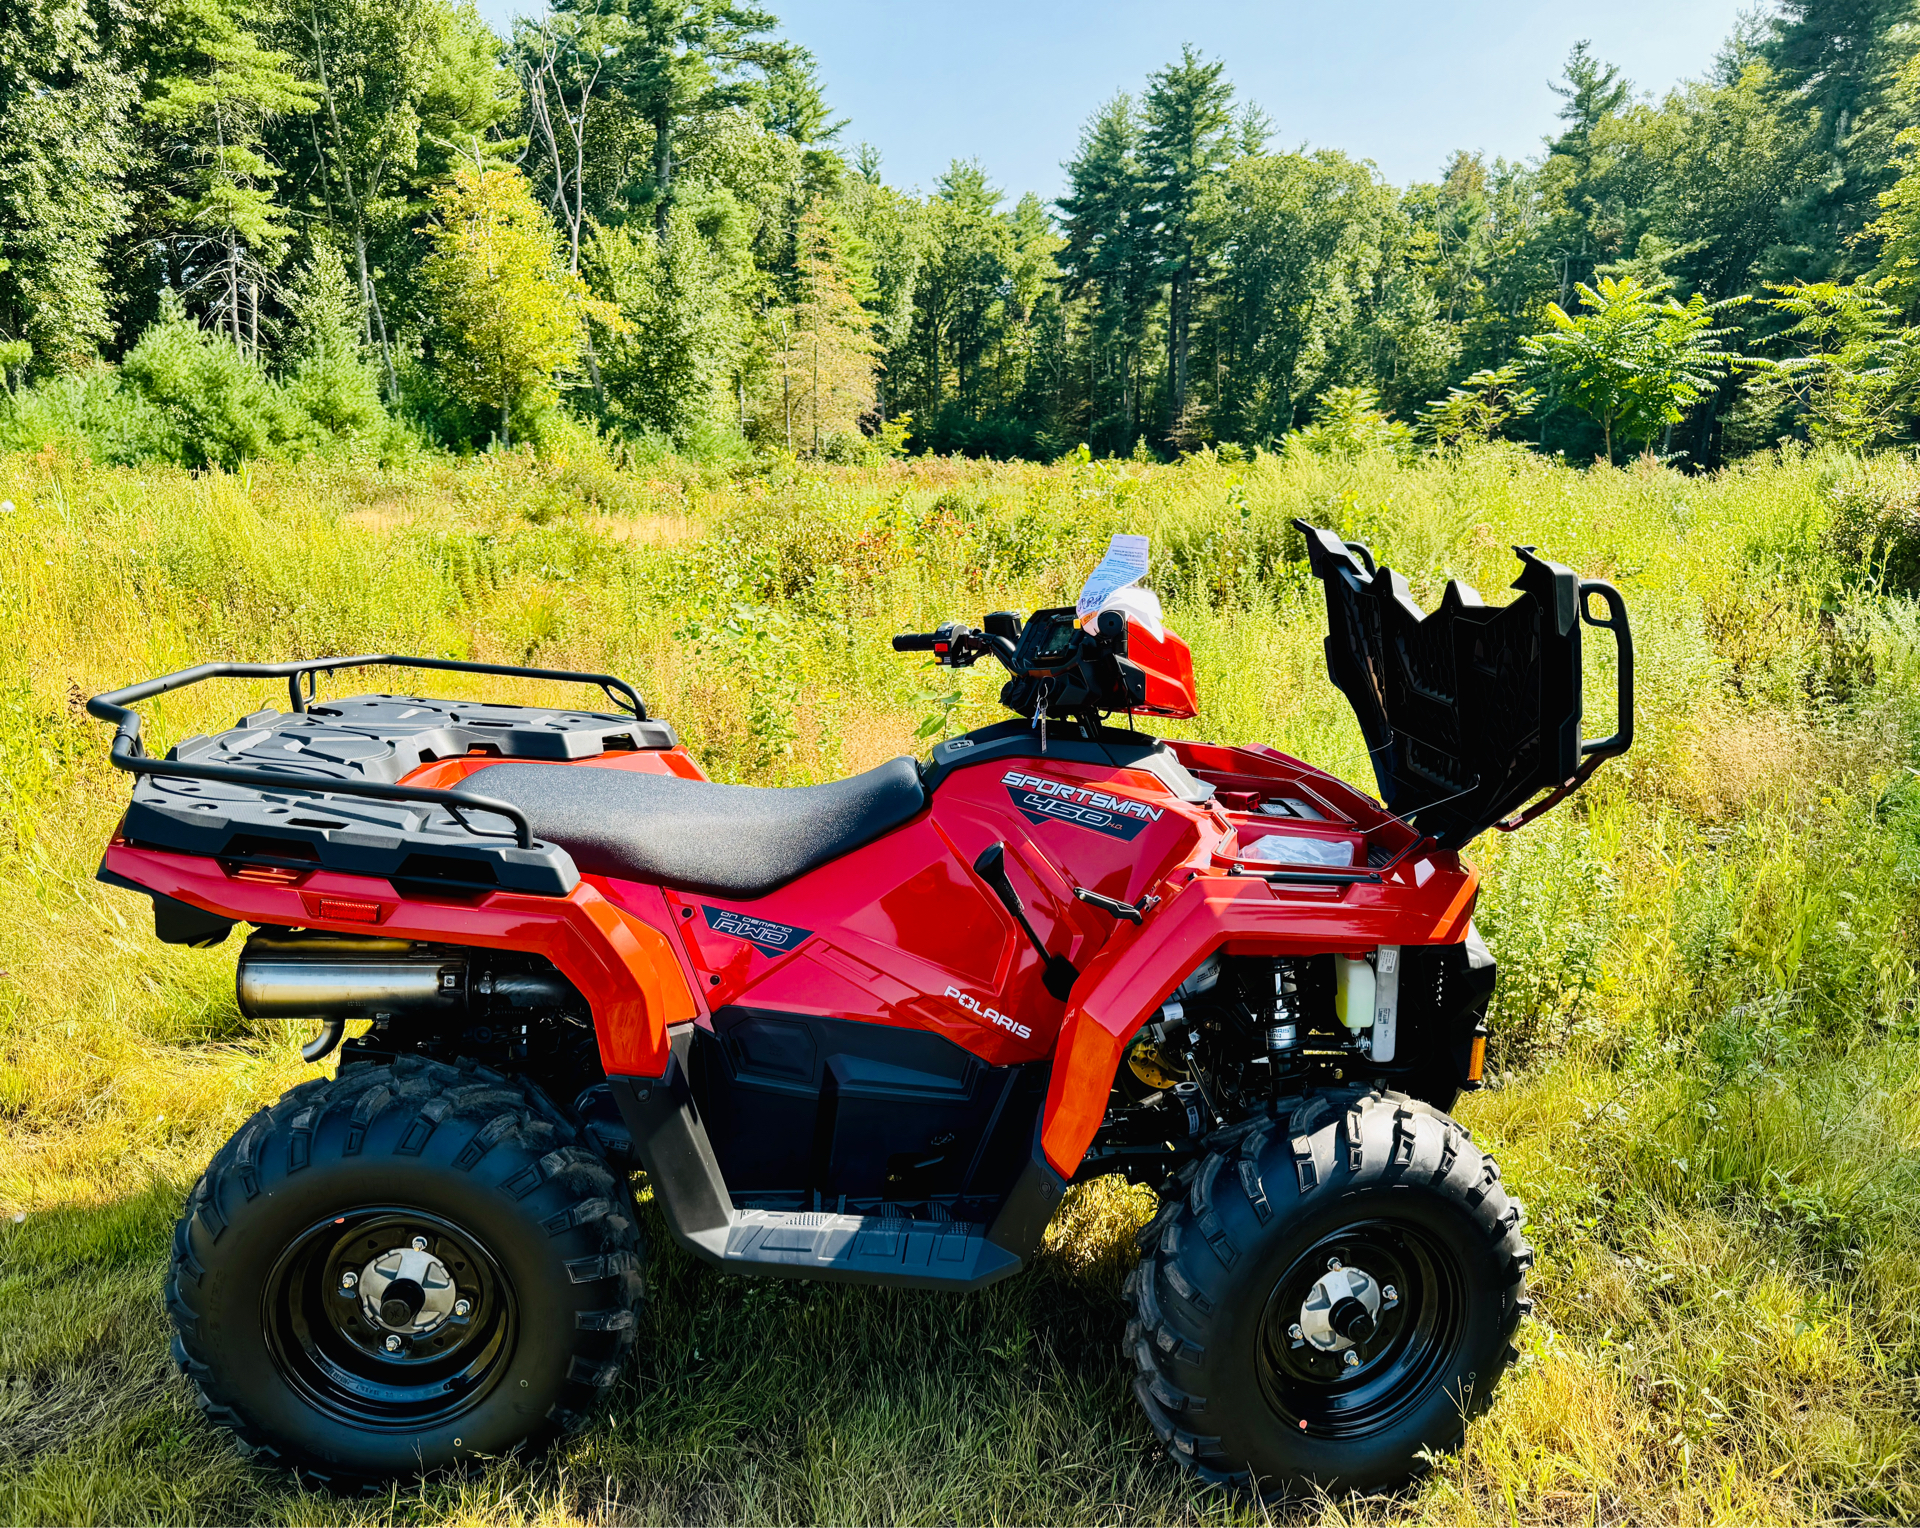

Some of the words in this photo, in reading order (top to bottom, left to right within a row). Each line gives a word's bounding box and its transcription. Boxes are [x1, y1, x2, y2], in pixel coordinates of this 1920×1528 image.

[1001, 771, 1164, 822] SPORTSMAN
[1023, 793, 1112, 827] 450
[712, 917, 789, 945] AWD
[720, 911, 738, 920] ON
[742, 916, 793, 934] DEMAND
[943, 985, 1033, 1040] POLARIS
